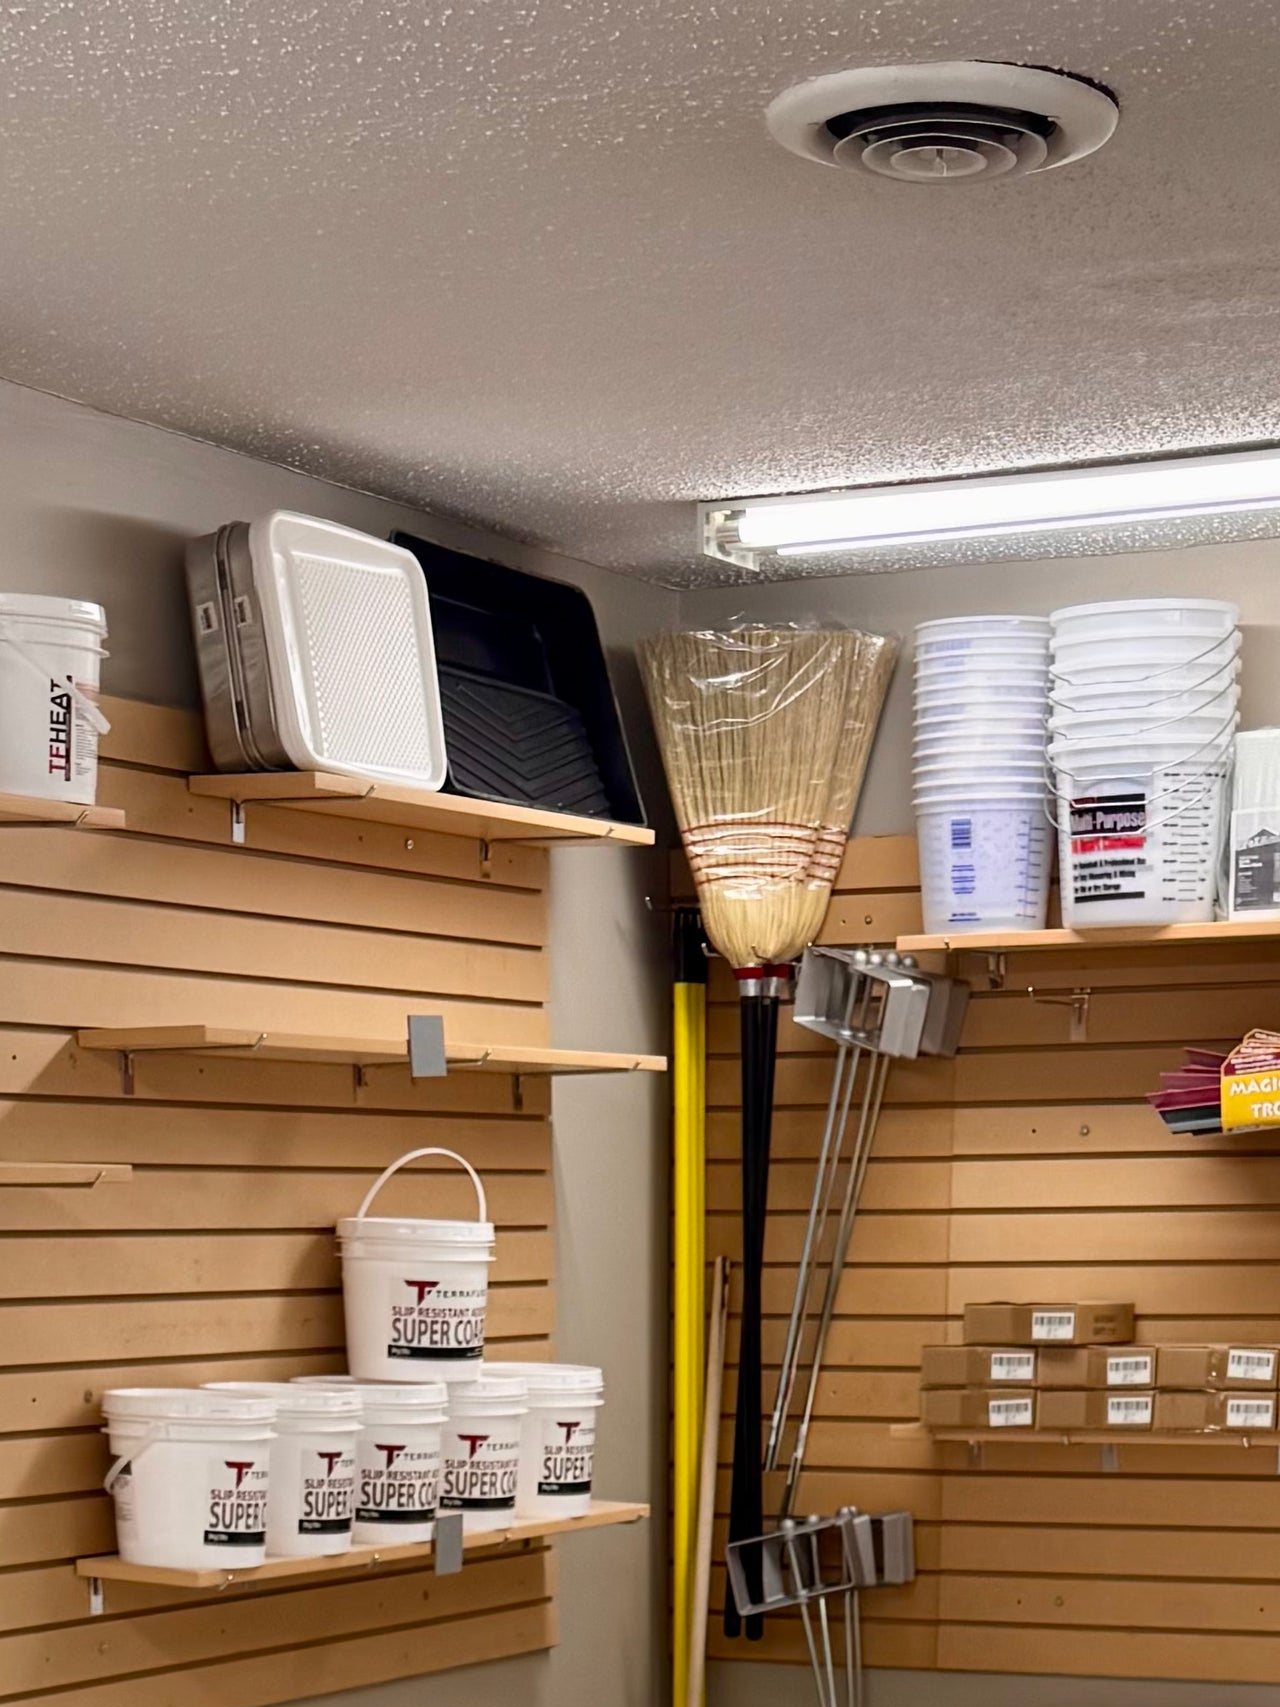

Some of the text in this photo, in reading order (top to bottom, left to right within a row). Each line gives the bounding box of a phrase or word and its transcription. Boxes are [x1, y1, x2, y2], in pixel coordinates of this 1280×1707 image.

[392, 1318, 450, 1345] SUPER
[361, 1482, 416, 1508] SUPER
[444, 1472, 497, 1496] SUPER
[209, 1502, 258, 1529] SUPER
[304, 1491, 348, 1518] SUPER
